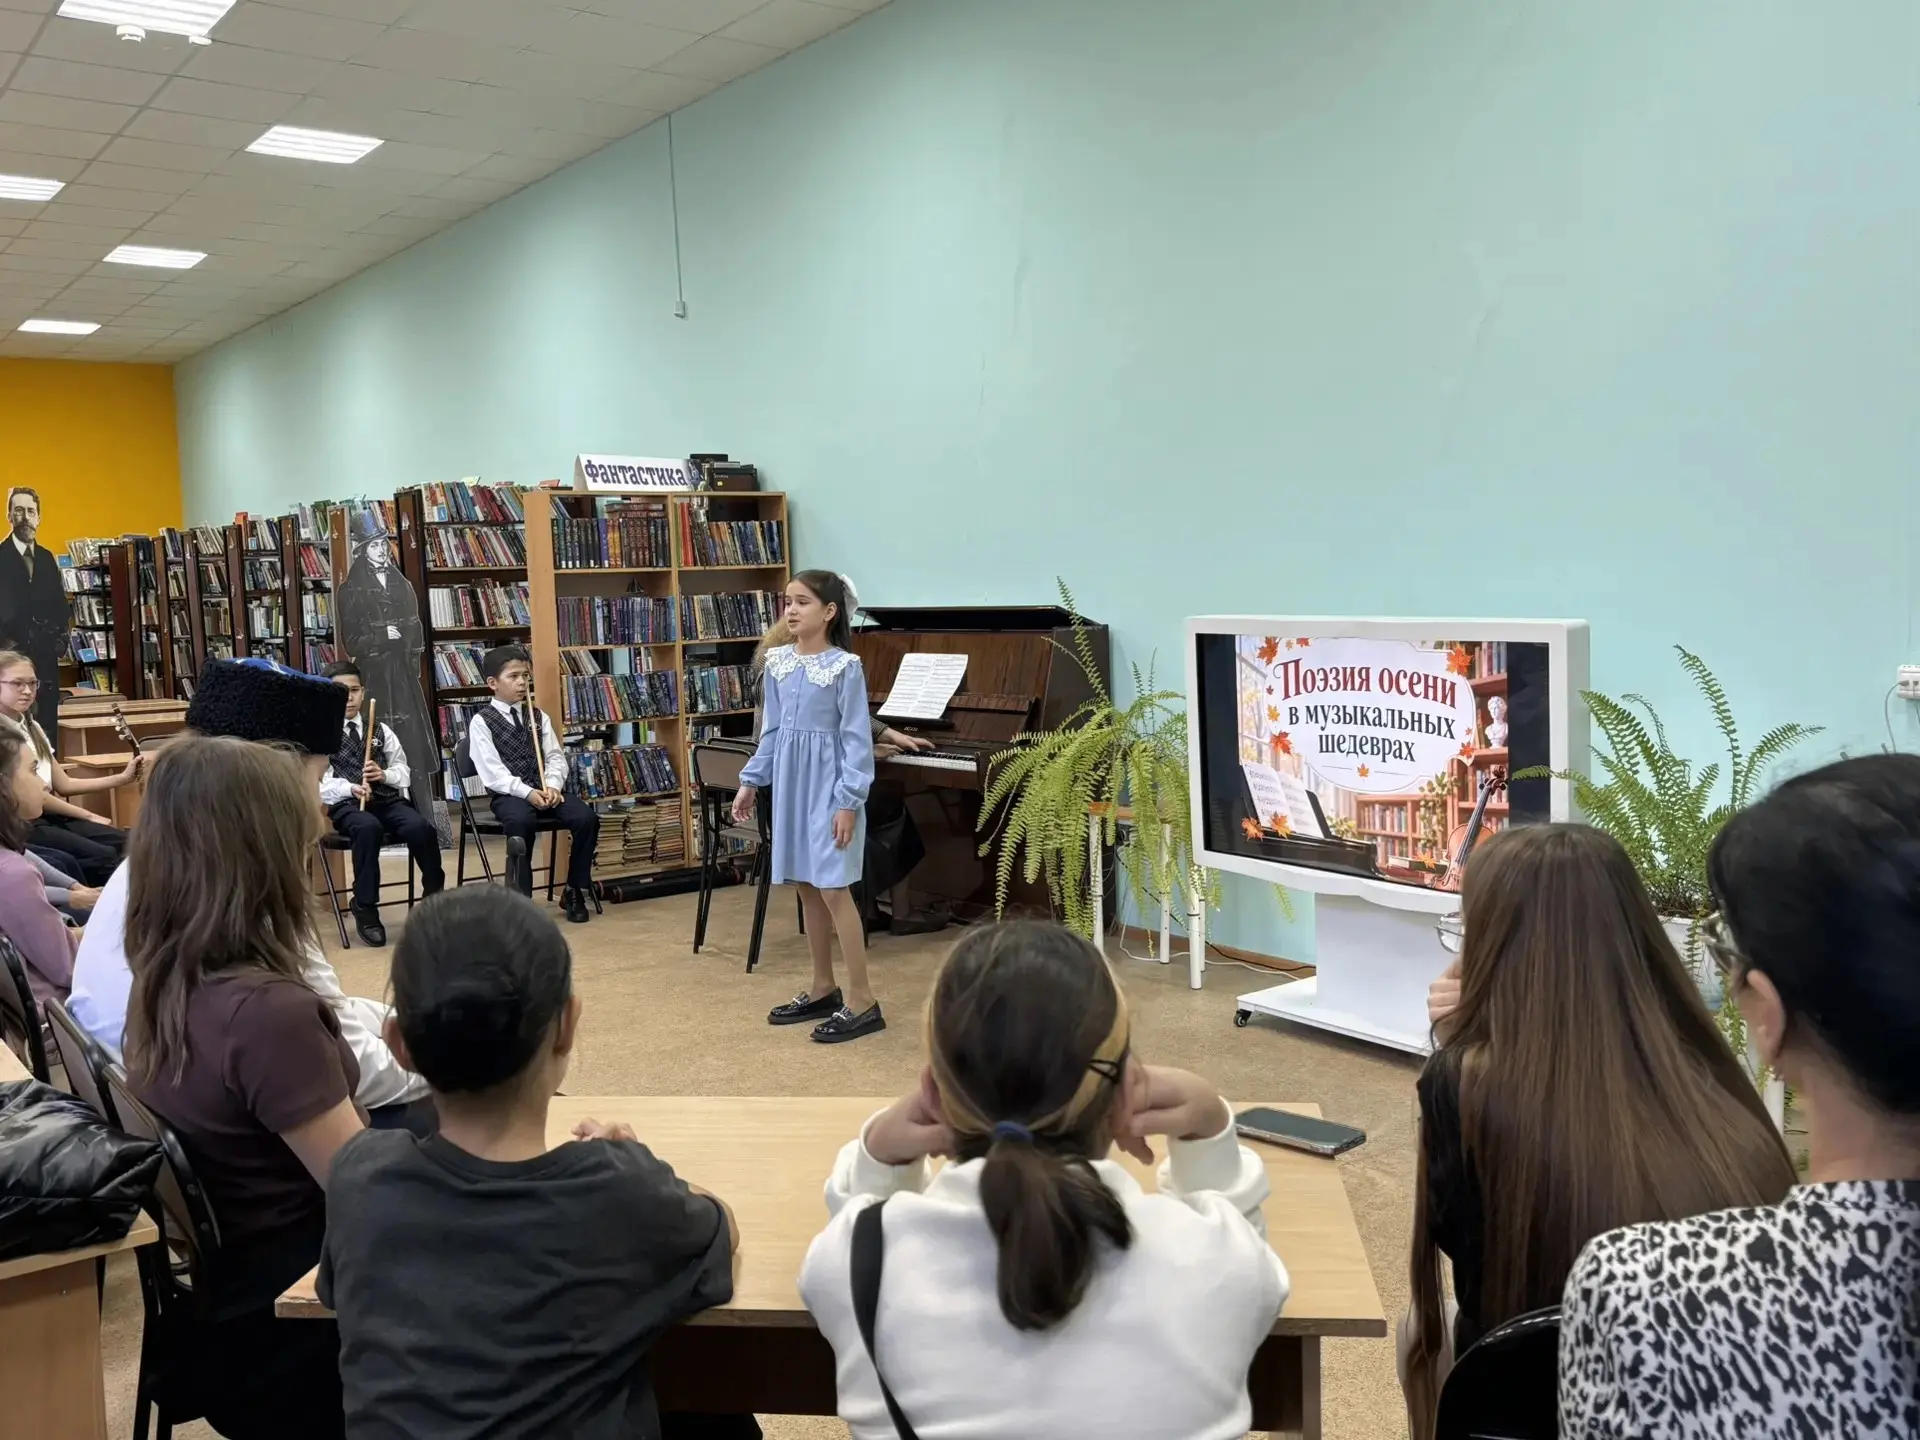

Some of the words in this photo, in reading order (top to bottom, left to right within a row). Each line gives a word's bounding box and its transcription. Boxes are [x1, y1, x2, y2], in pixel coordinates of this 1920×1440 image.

[584, 459, 688, 486] Фантастика
[1273, 658, 1371, 701] Поэзия
[1378, 667, 1457, 709] осени
[1288, 706, 1300, 726] в
[1305, 704, 1456, 740] музыкальных
[1318, 734, 1416, 763] шедеврах
